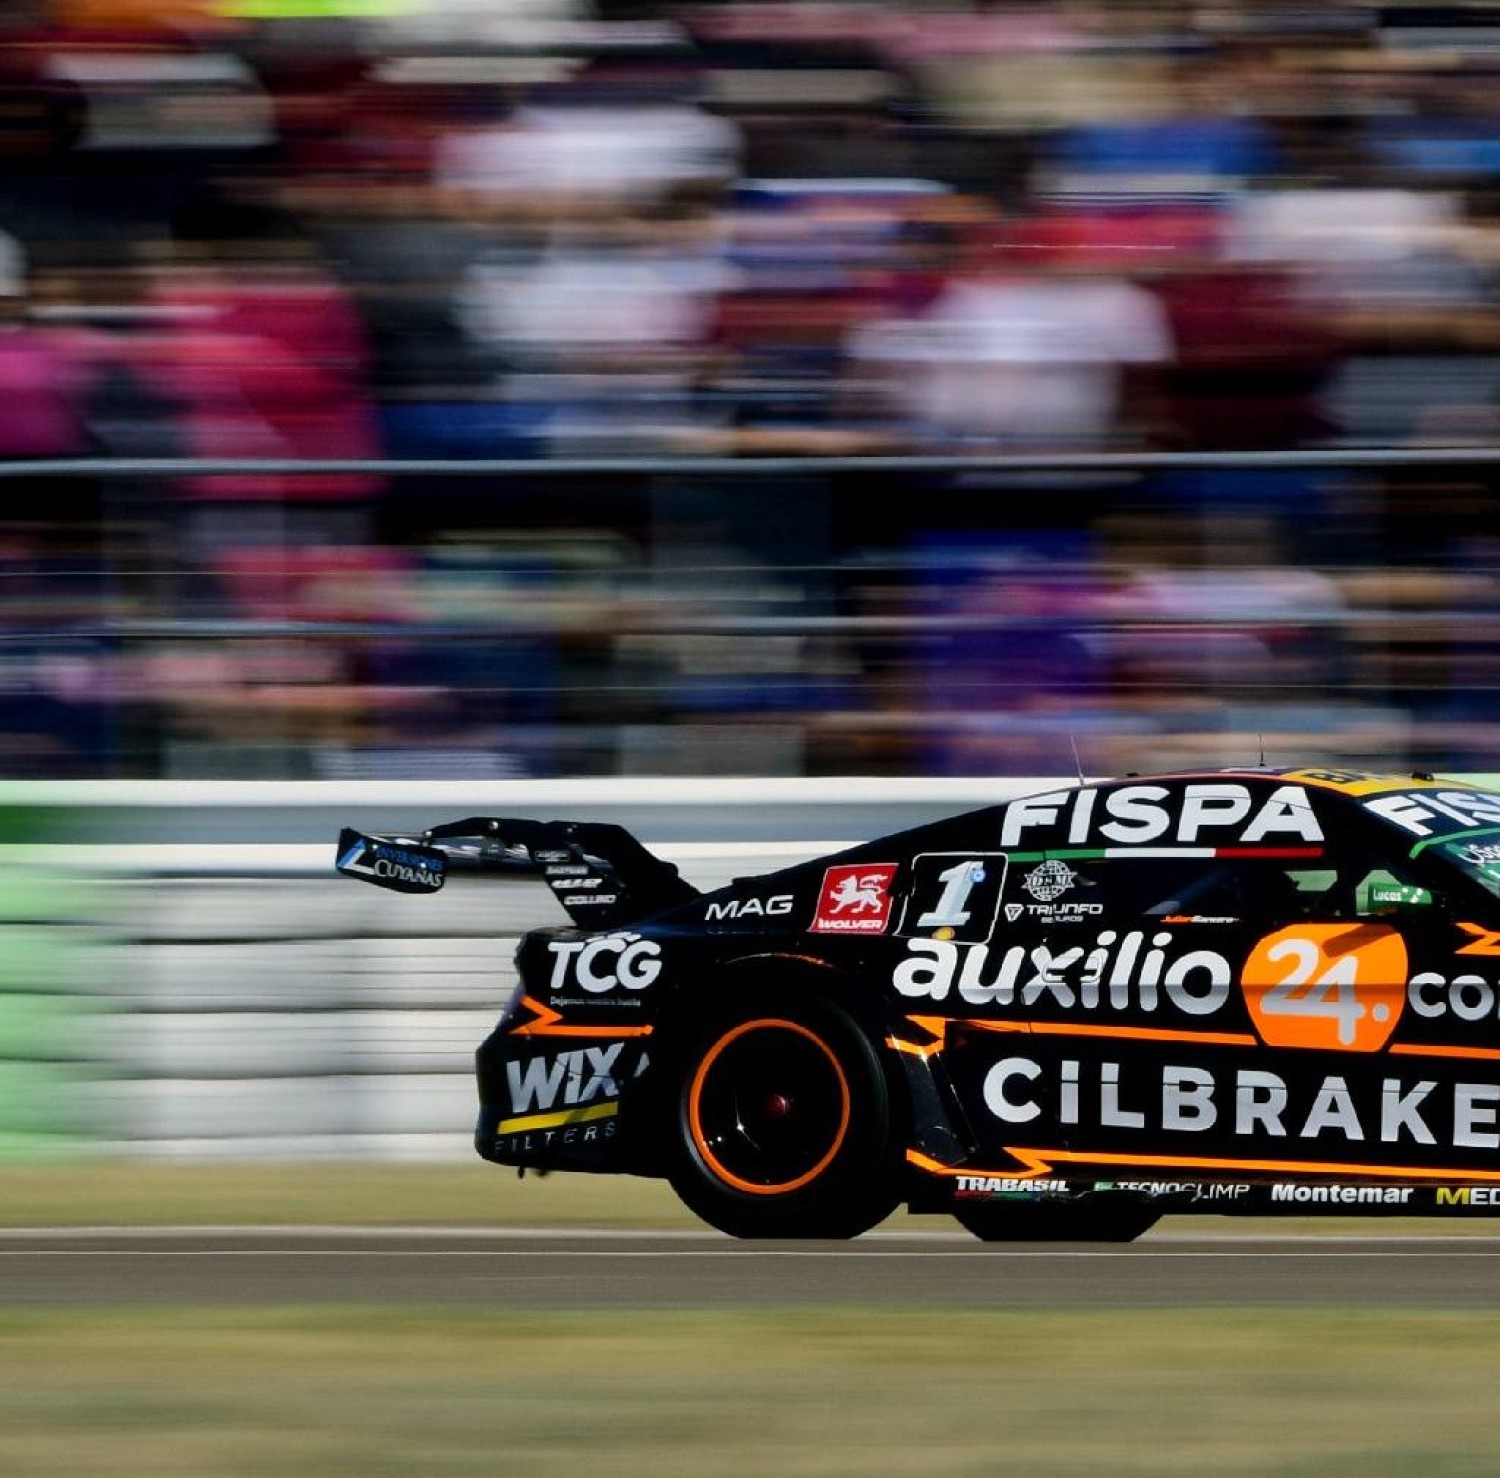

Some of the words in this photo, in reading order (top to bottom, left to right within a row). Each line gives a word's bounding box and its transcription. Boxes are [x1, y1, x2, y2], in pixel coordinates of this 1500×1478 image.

[1000, 784, 1325, 847] FISPA
[703, 894, 795, 921] MAG
[916, 860, 985, 927] 1
[1026, 903, 1104, 916] TRIUNFO
[817, 918, 883, 931] WOLVER
[547, 937, 663, 994] TCG
[506, 1041, 625, 1114] WIX
[982, 1057, 1500, 1149] CILBRAKE
[493, 1121, 617, 1154] FILTERS
[956, 1175, 1070, 1192] TRABASIL
[1270, 1184, 1414, 1203] Montemar
